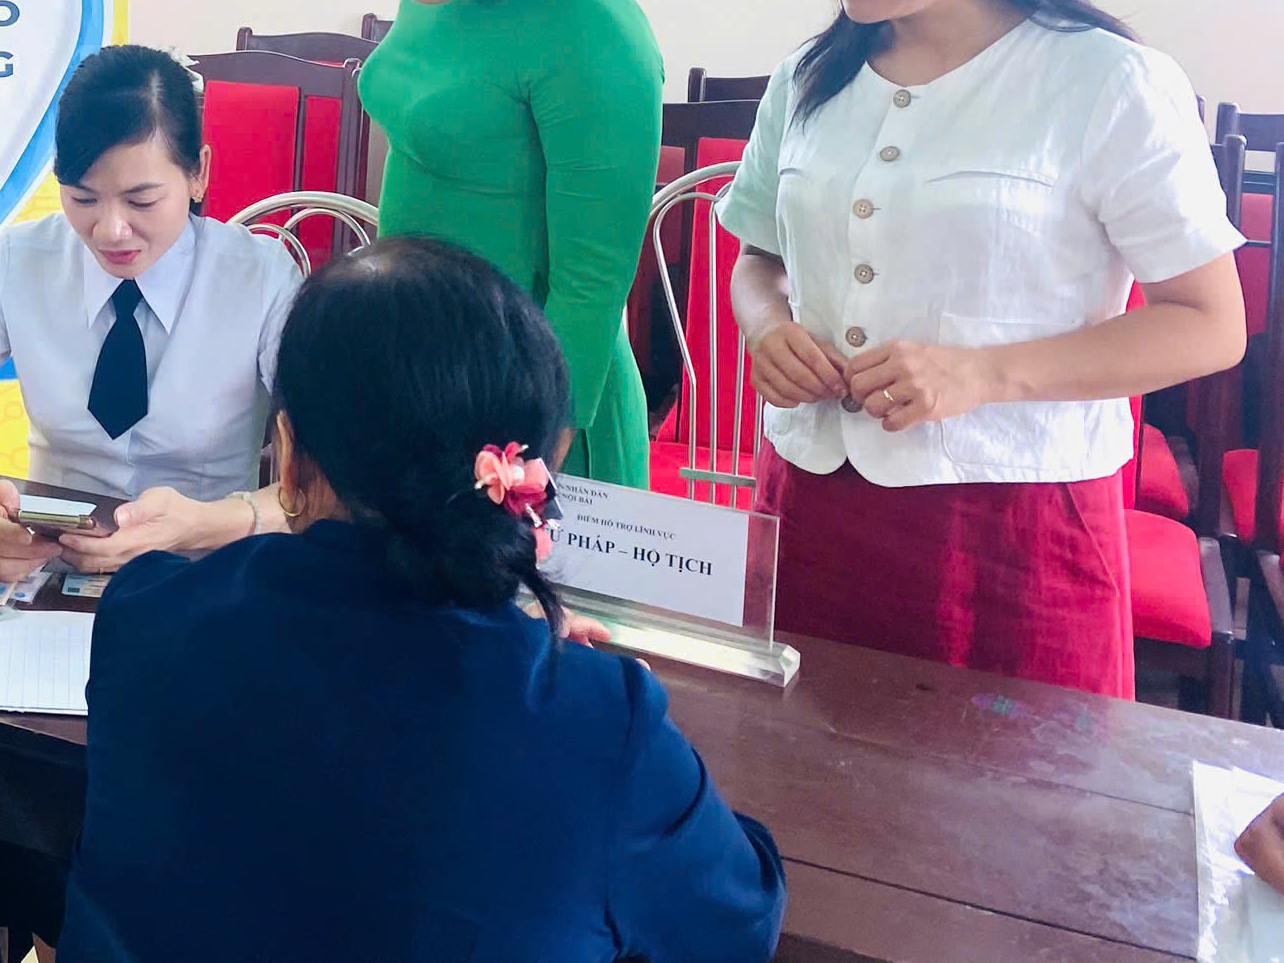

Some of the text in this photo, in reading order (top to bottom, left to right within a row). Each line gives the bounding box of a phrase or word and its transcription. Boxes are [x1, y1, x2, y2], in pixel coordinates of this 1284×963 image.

[615, 522, 634, 532] TRỢ
[568, 533, 615, 554] PHÁP
[633, 546, 660, 567] HỘ
[665, 552, 712, 576] TỊCH
